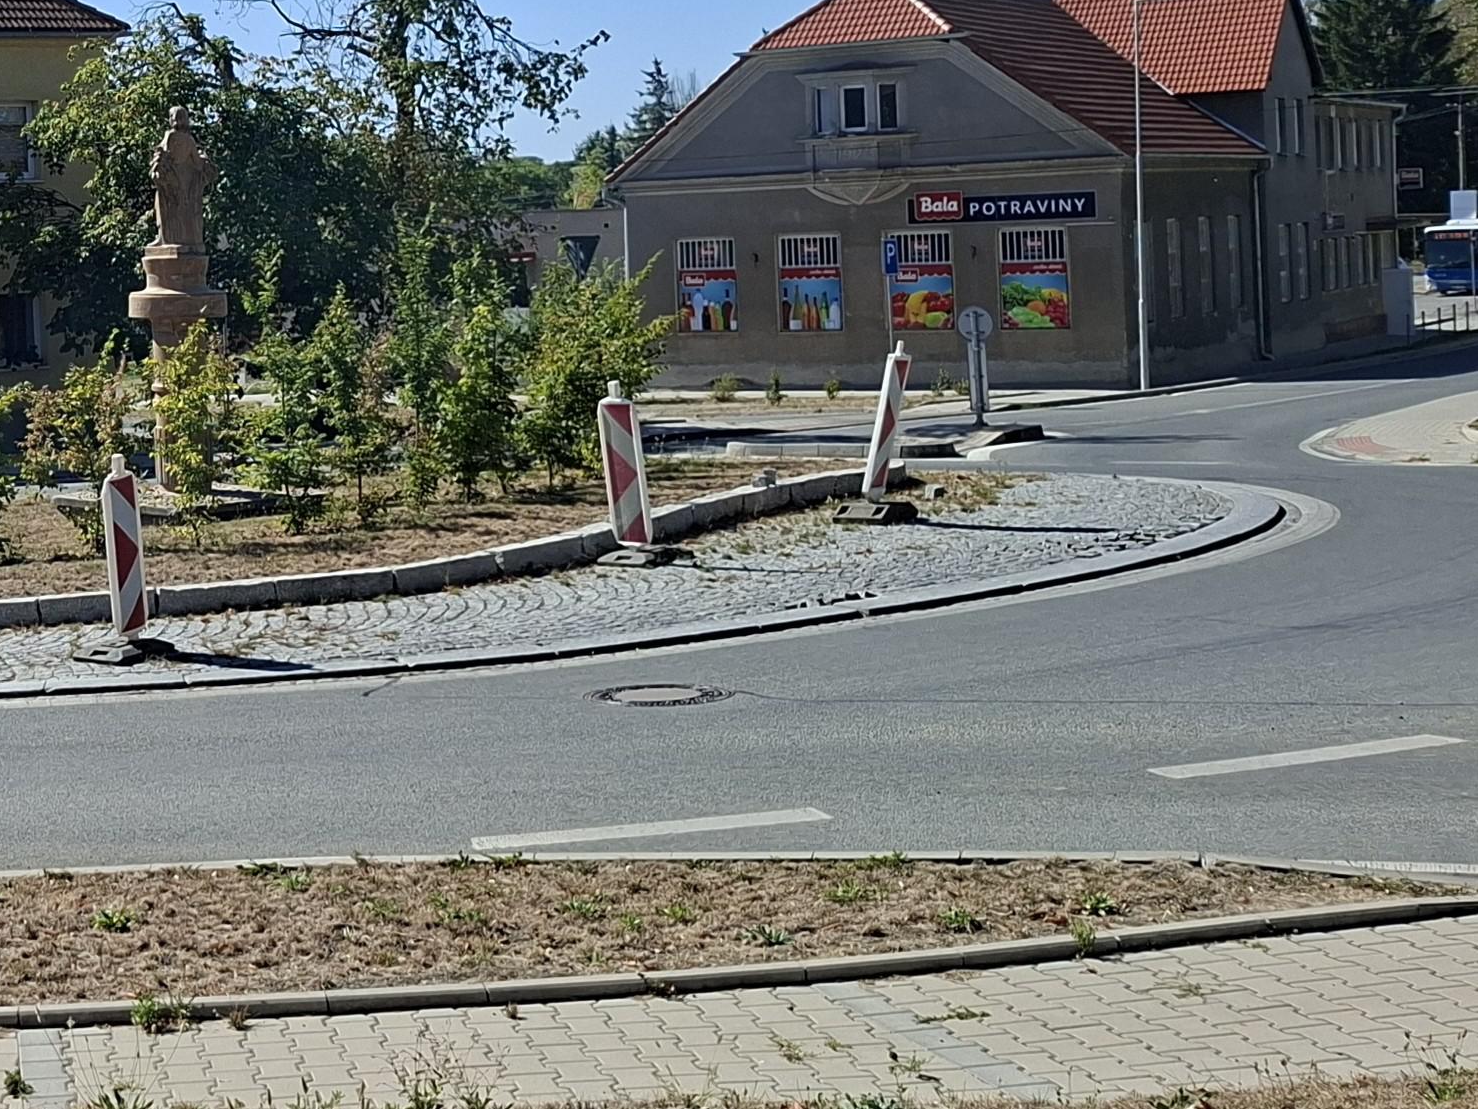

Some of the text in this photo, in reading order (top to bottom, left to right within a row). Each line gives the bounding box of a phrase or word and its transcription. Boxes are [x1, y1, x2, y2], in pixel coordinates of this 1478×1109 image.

[919, 196, 1086, 216] Bala POTRAVINY
[886, 243, 896, 265] P
